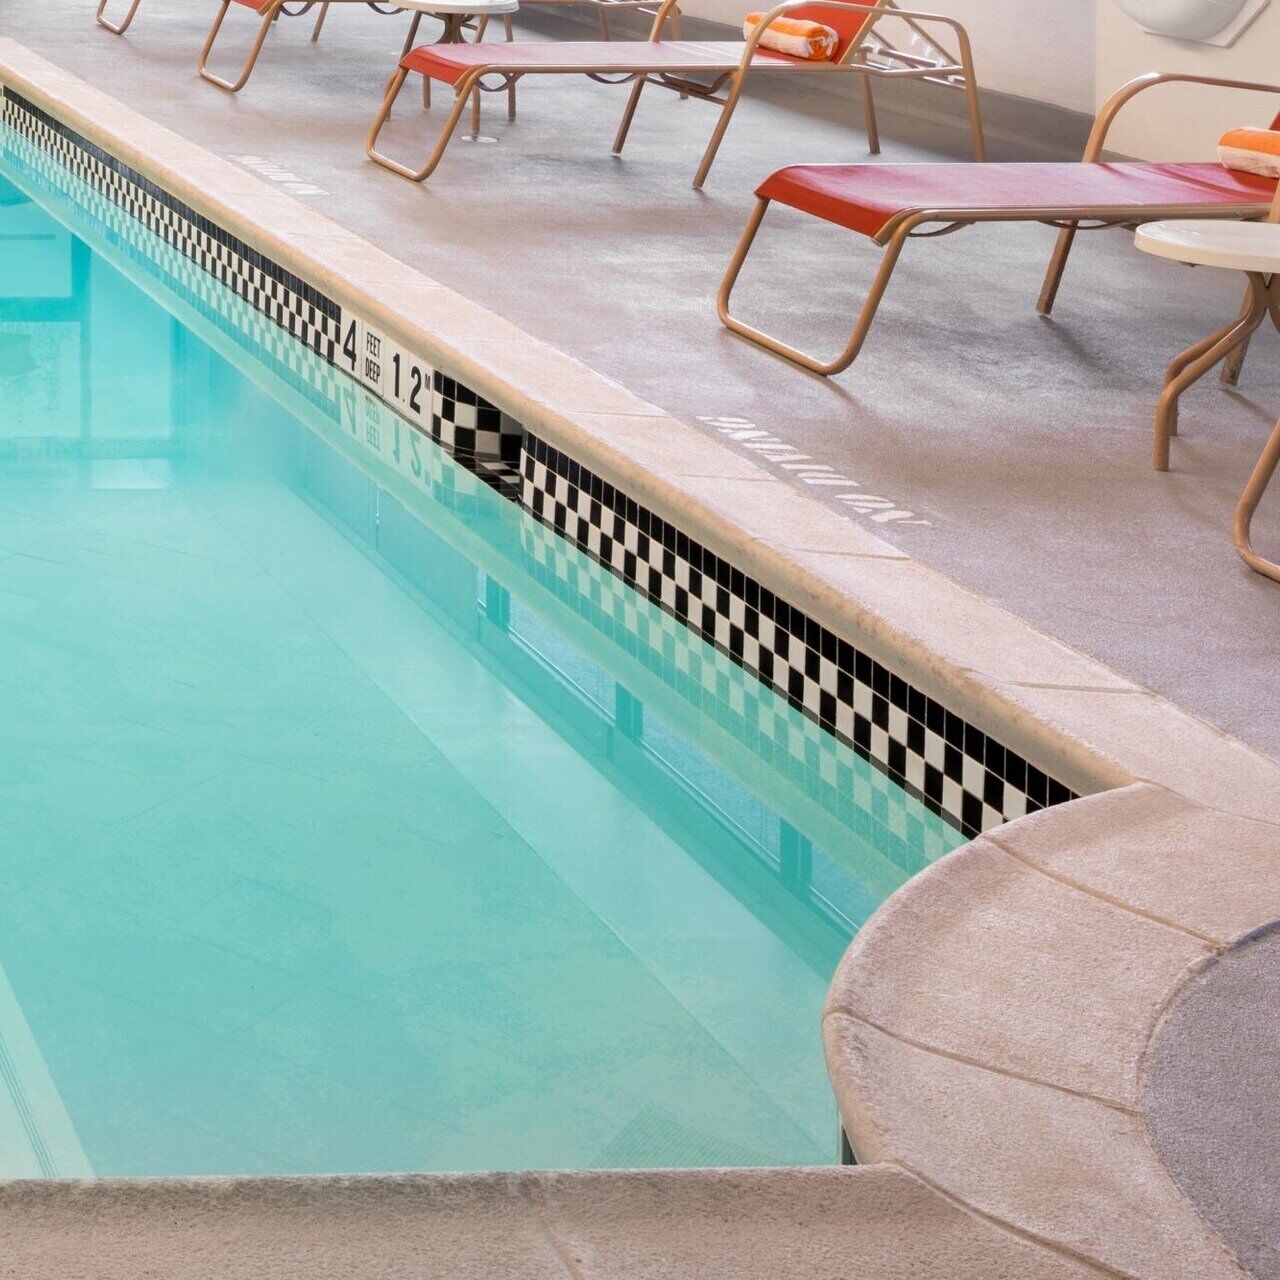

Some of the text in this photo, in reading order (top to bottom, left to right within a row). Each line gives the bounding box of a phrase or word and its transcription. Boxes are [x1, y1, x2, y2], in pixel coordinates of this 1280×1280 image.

[342, 319, 357, 372] 4
[366, 331, 382, 359] FEET
[365, 357, 381, 384] DEEP
[695, 415, 933, 526] NO DIVING
